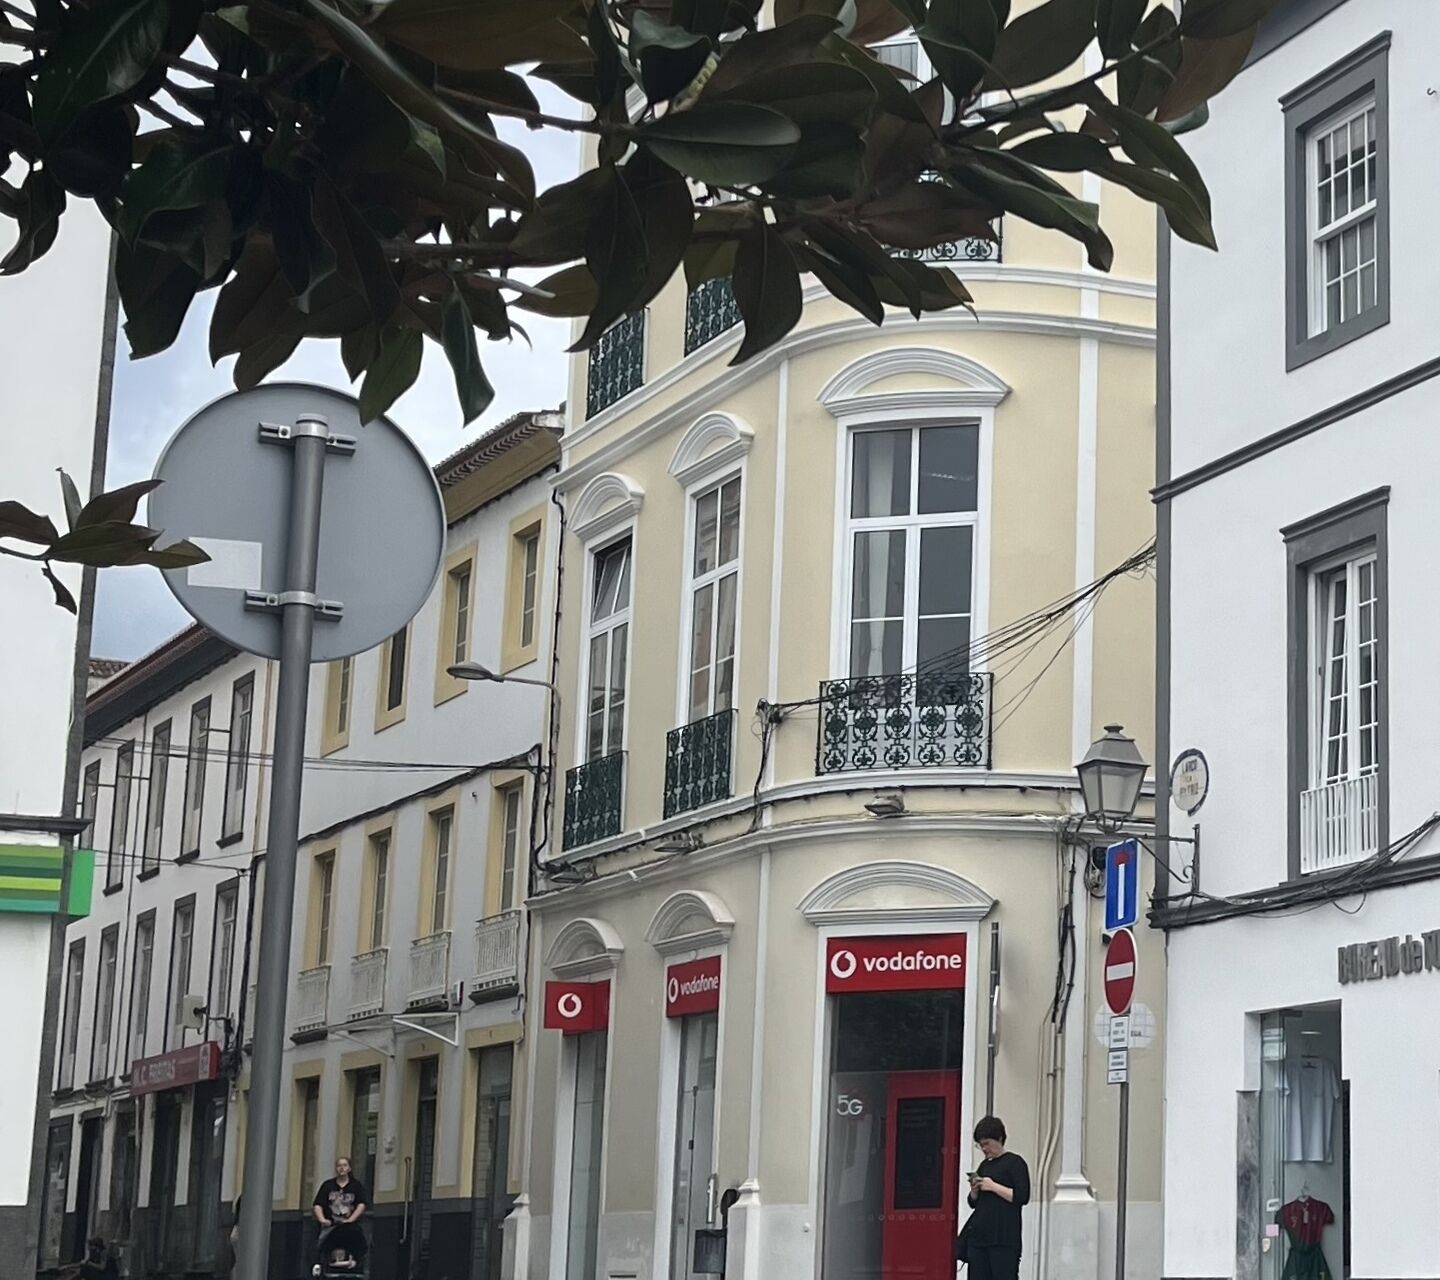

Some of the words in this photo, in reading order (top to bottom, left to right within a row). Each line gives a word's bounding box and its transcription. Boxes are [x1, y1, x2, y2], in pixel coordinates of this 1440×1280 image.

[863, 950, 962, 971] vodafone
[1338, 936, 1400, 986] BUREAU
[1400, 934, 1423, 975] de
[680, 973, 719, 995] vodafone
[836, 1095, 863, 1116] 5G
